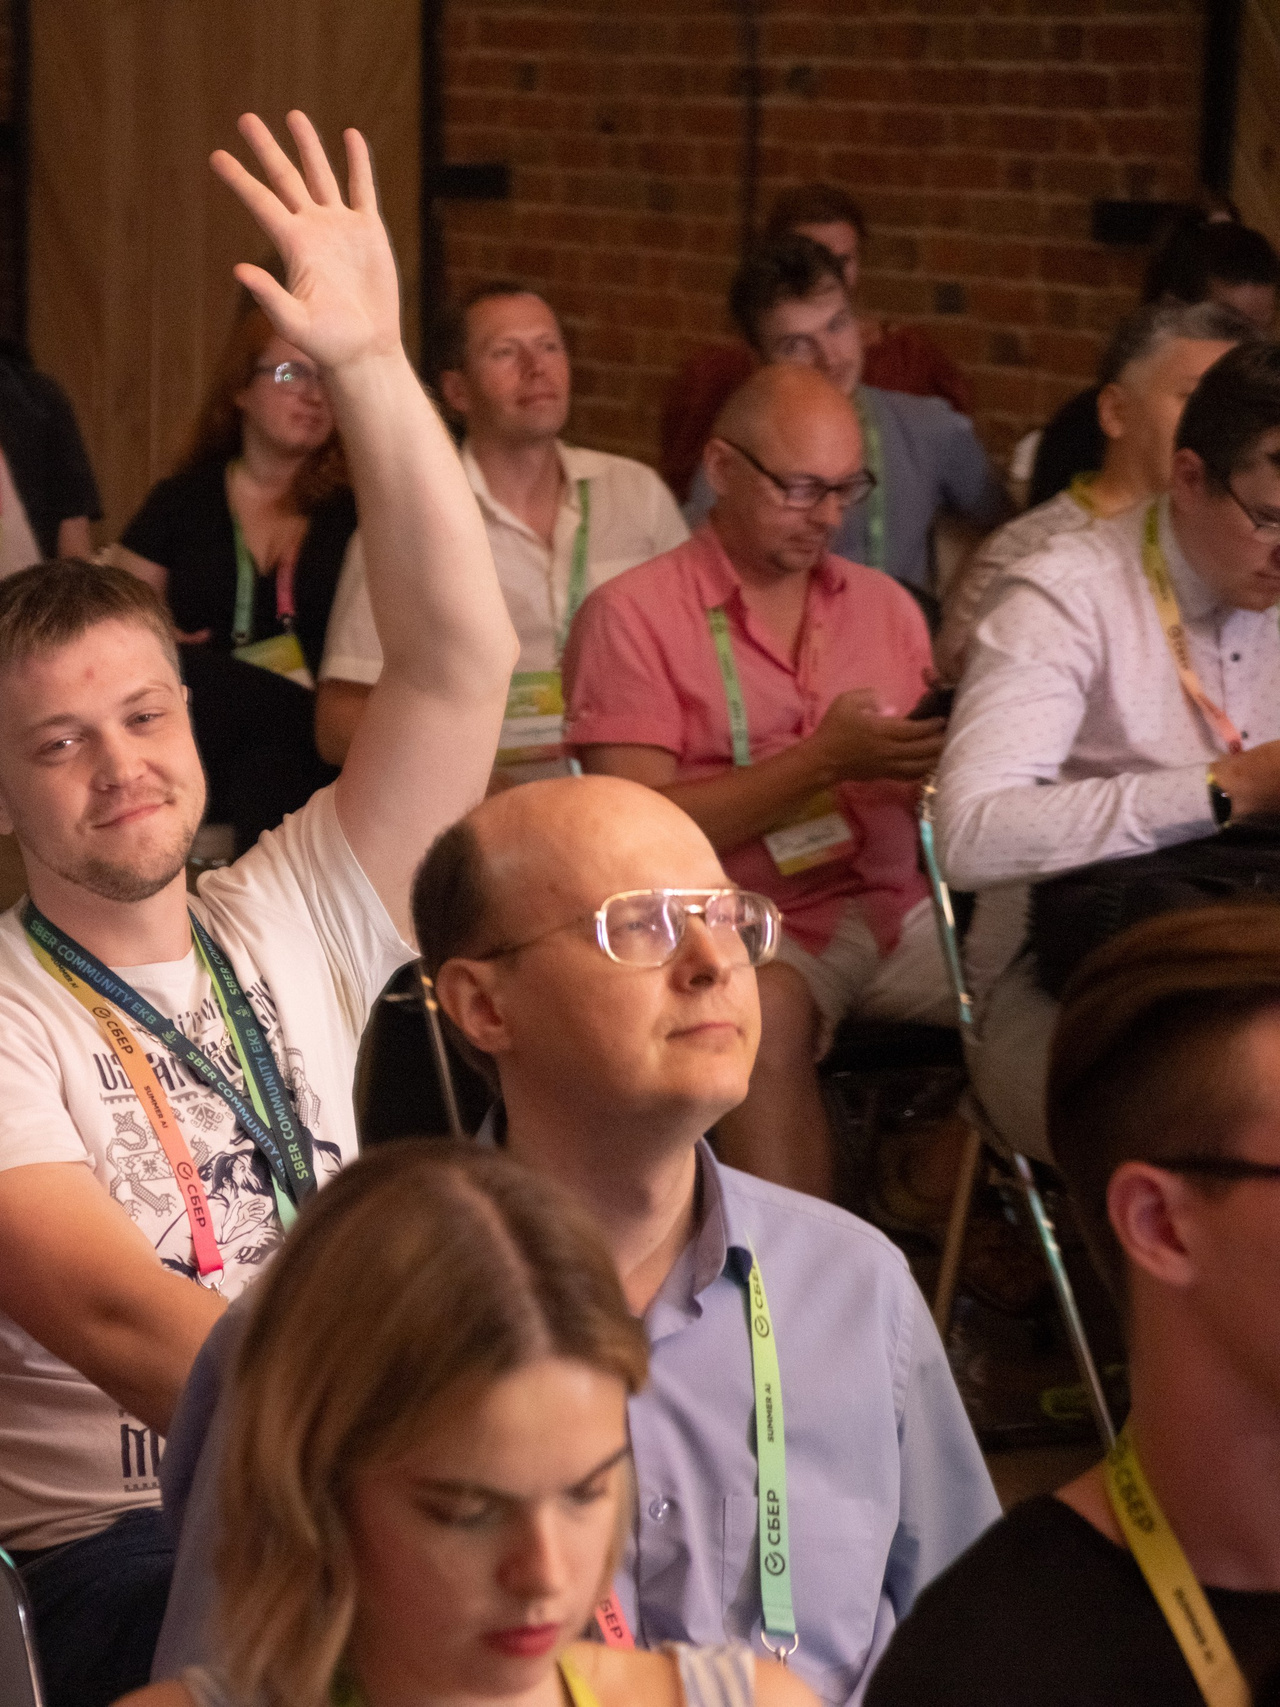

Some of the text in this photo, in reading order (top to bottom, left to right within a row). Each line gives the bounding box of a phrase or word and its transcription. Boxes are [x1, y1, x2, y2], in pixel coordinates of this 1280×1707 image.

[30, 920, 58, 949] SBER
[57, 944, 133, 1003] COMMUNITY
[130, 1001, 157, 1025] EKB
[220, 967, 240, 995] SBER
[106, 1020, 134, 1055] СБЕР
[246, 1027, 263, 1055] EKB
[144, 1085, 169, 1129] SUMMER AI
[186, 1051, 218, 1082] SBER
[217, 1081, 280, 1158] COMMUNITY
[255, 1056, 295, 1140] COMMUNITY
[287, 1142, 309, 1180] SBER
[187, 1184, 207, 1228] СБЕР
[764, 1383, 775, 1443] SUMMER AI
[767, 1490, 781, 1546] СБЕР
[601, 1599, 623, 1639] БЕР
